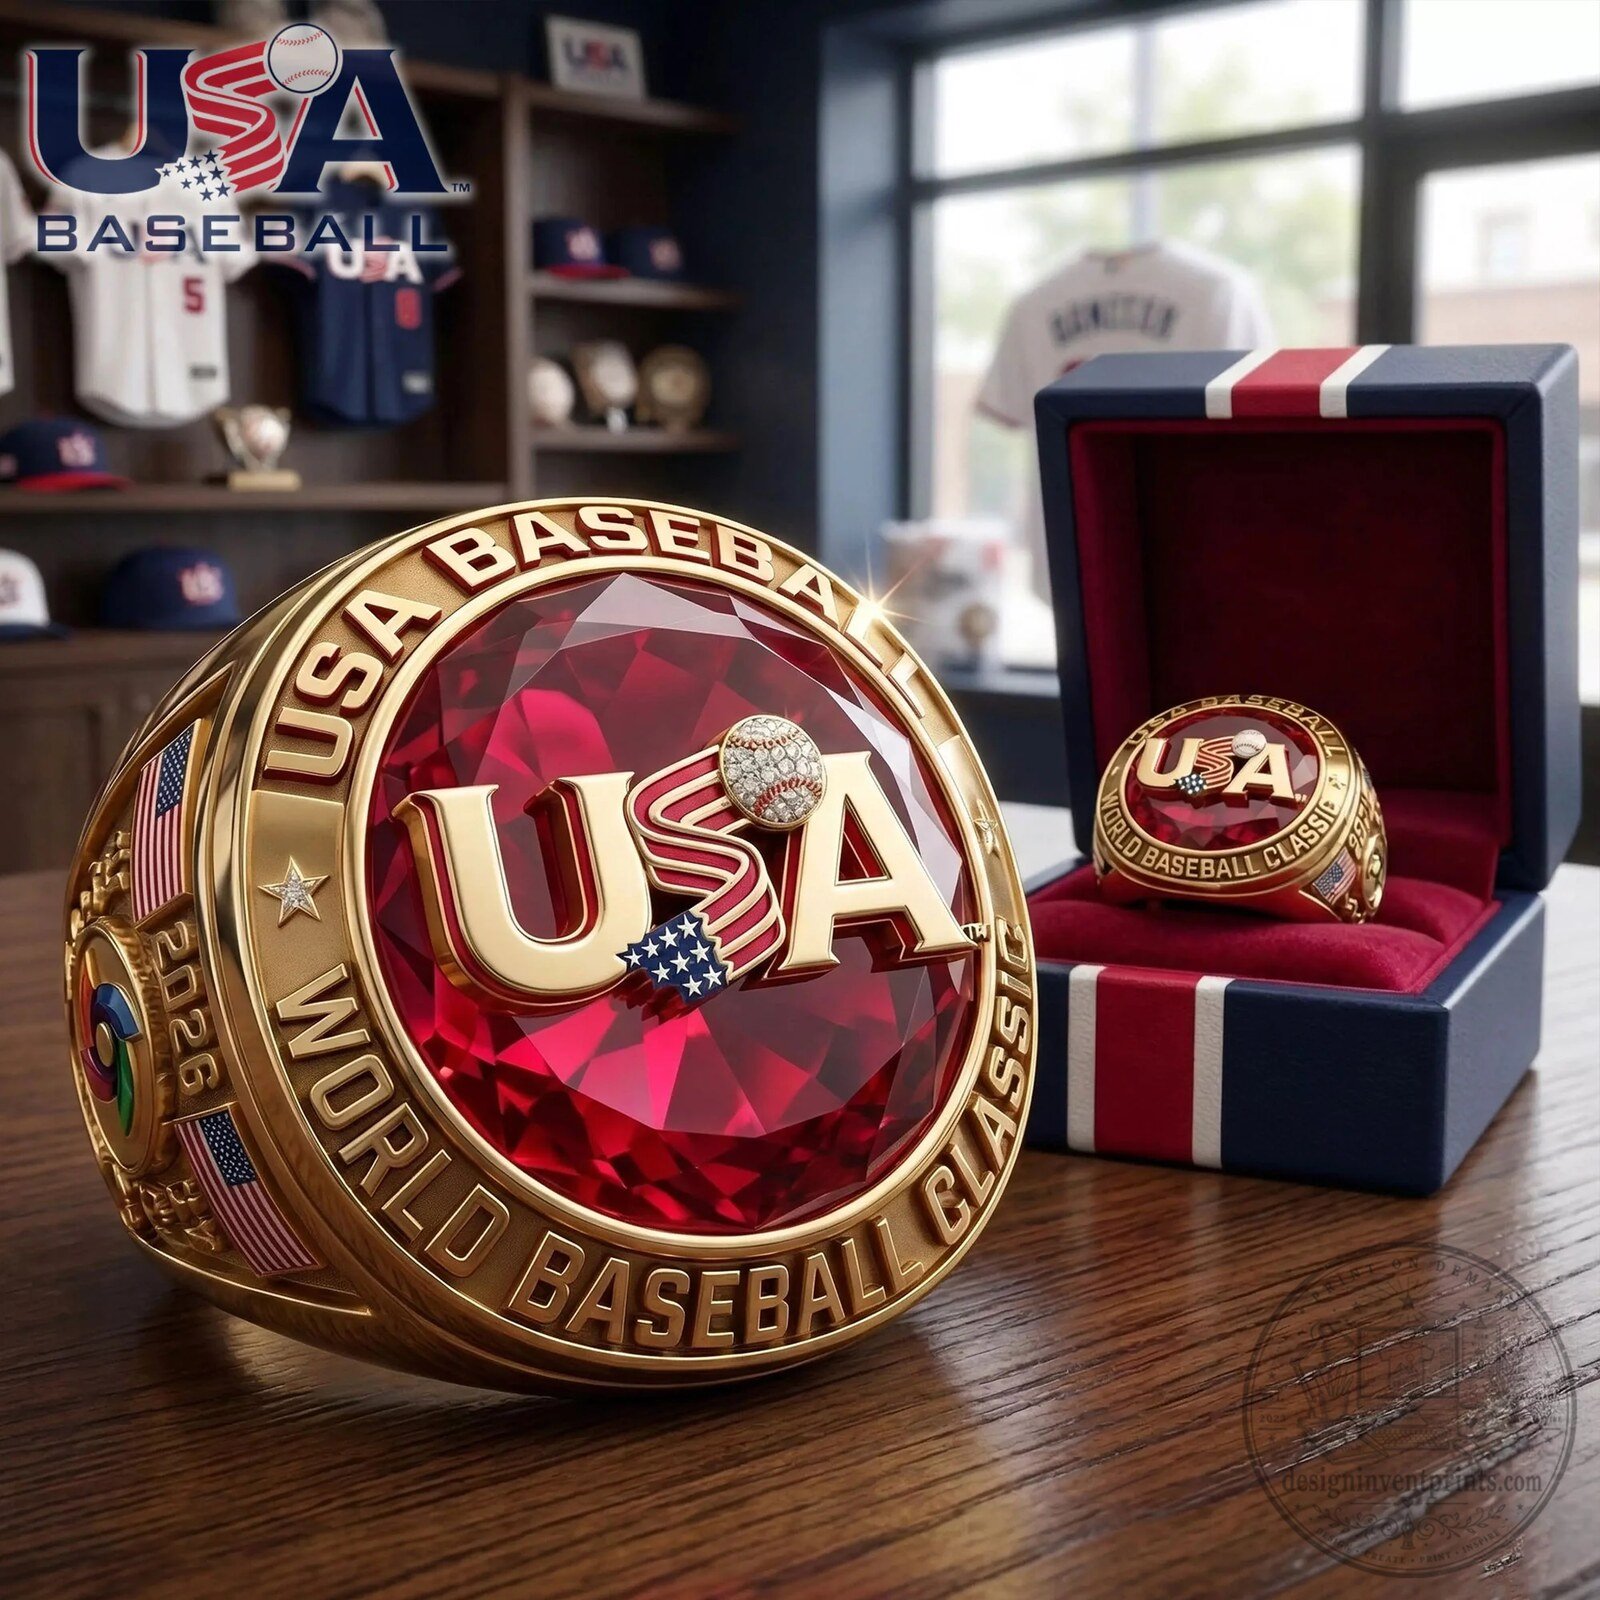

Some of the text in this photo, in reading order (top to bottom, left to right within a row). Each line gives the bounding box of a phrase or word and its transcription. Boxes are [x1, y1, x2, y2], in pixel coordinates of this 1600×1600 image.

[183, 277, 206, 314] 5
[263, 506, 926, 785] USA BASEBALL
[1100, 788, 1143, 858] WORLD
[1140, 850, 1261, 880] BASEBALL
[1262, 798, 1344, 869] CLASSIC
[1136, 729, 1295, 800] USA
[391, 714, 979, 1008] USA
[155, 920, 220, 1096] 2026
[275, 914, 1033, 1348] WORLD BASEBALL CLASSIC
